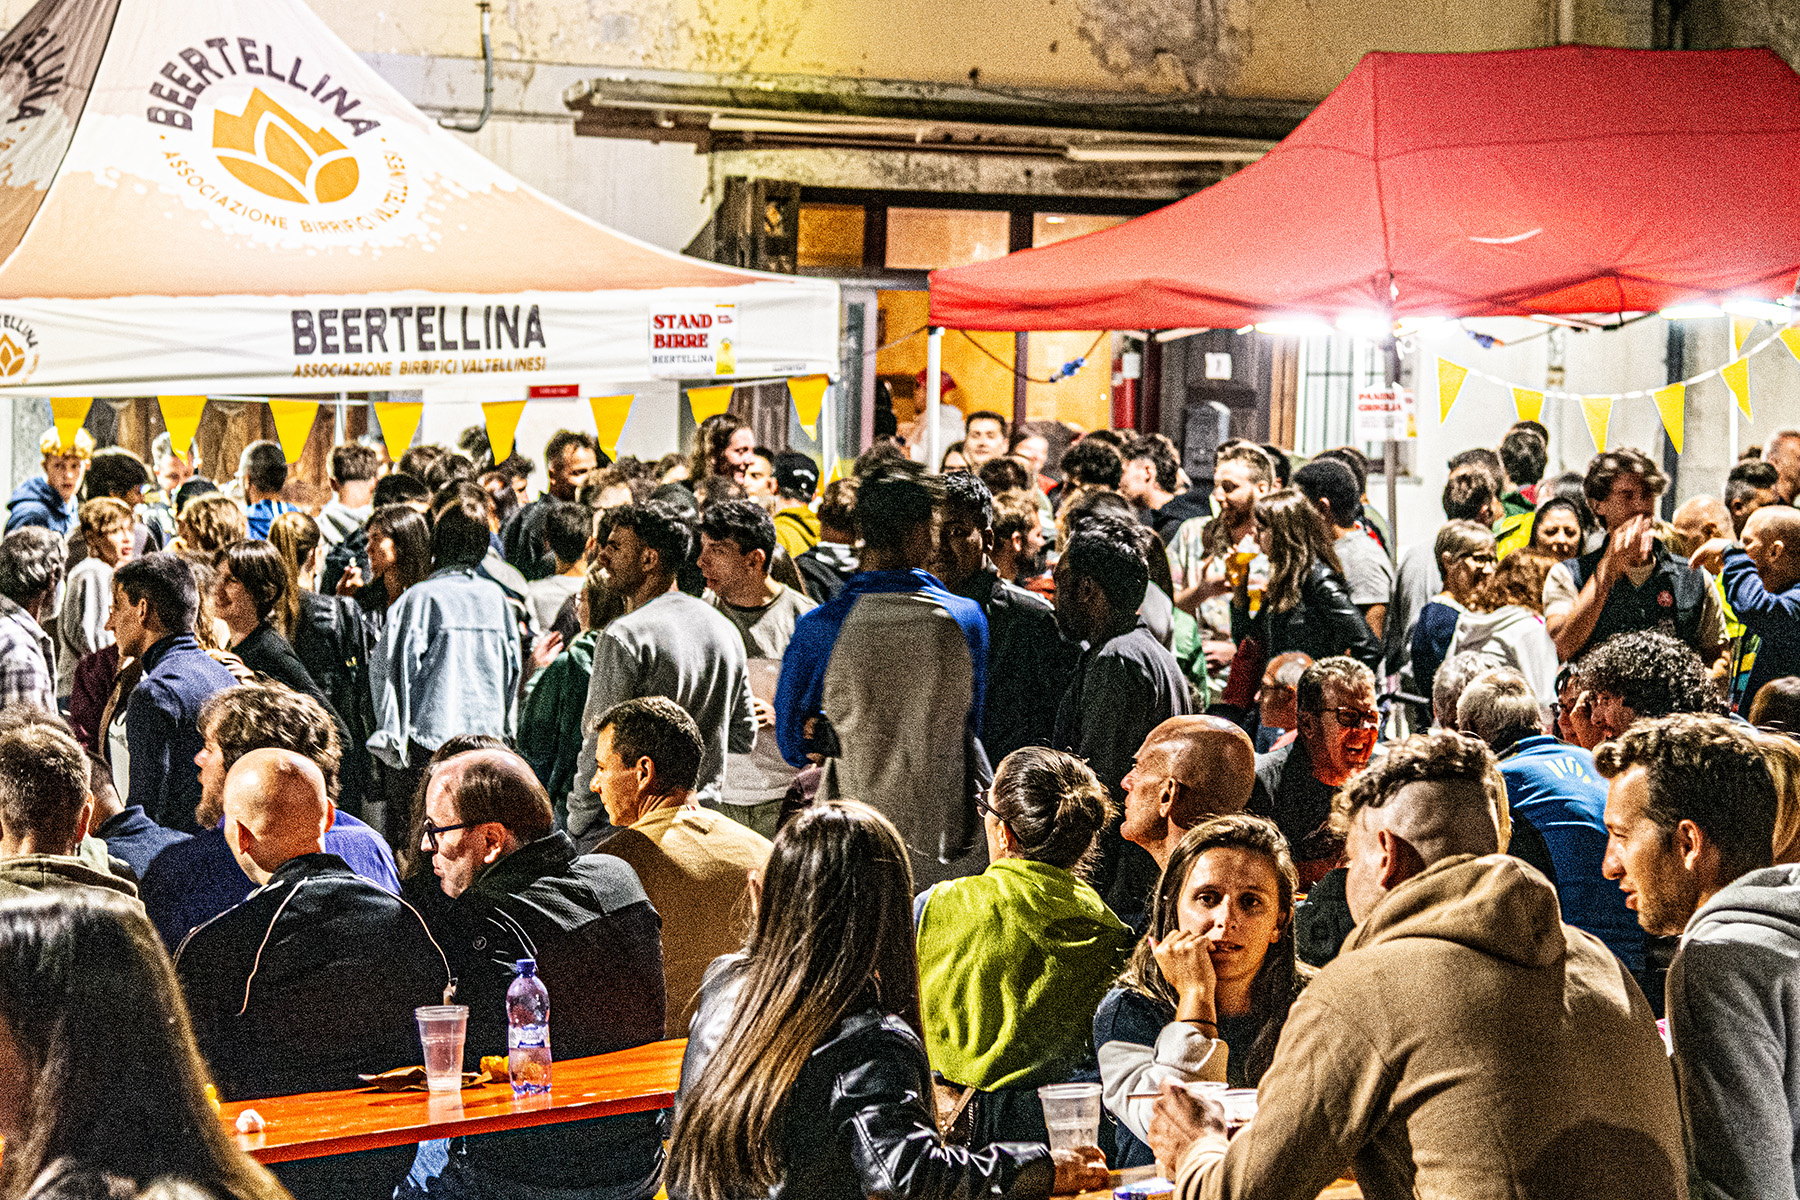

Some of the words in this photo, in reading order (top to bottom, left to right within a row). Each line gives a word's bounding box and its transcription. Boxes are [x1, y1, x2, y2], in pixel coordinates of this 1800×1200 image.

[147, 36, 381, 137] BEERTELLINA
[162, 151, 288, 230] ASSOCIAZIONE
[291, 304, 546, 355] BEERTELLINA
[653, 314, 712, 329] STAND
[654, 333, 708, 348] BIRRE
[292, 362, 392, 378] ASSOCIAZIONE
[399, 359, 457, 375] BIRRIFICI
[462, 356, 546, 374] VALTELLINESI
[652, 354, 713, 364] BEERTELLINA
